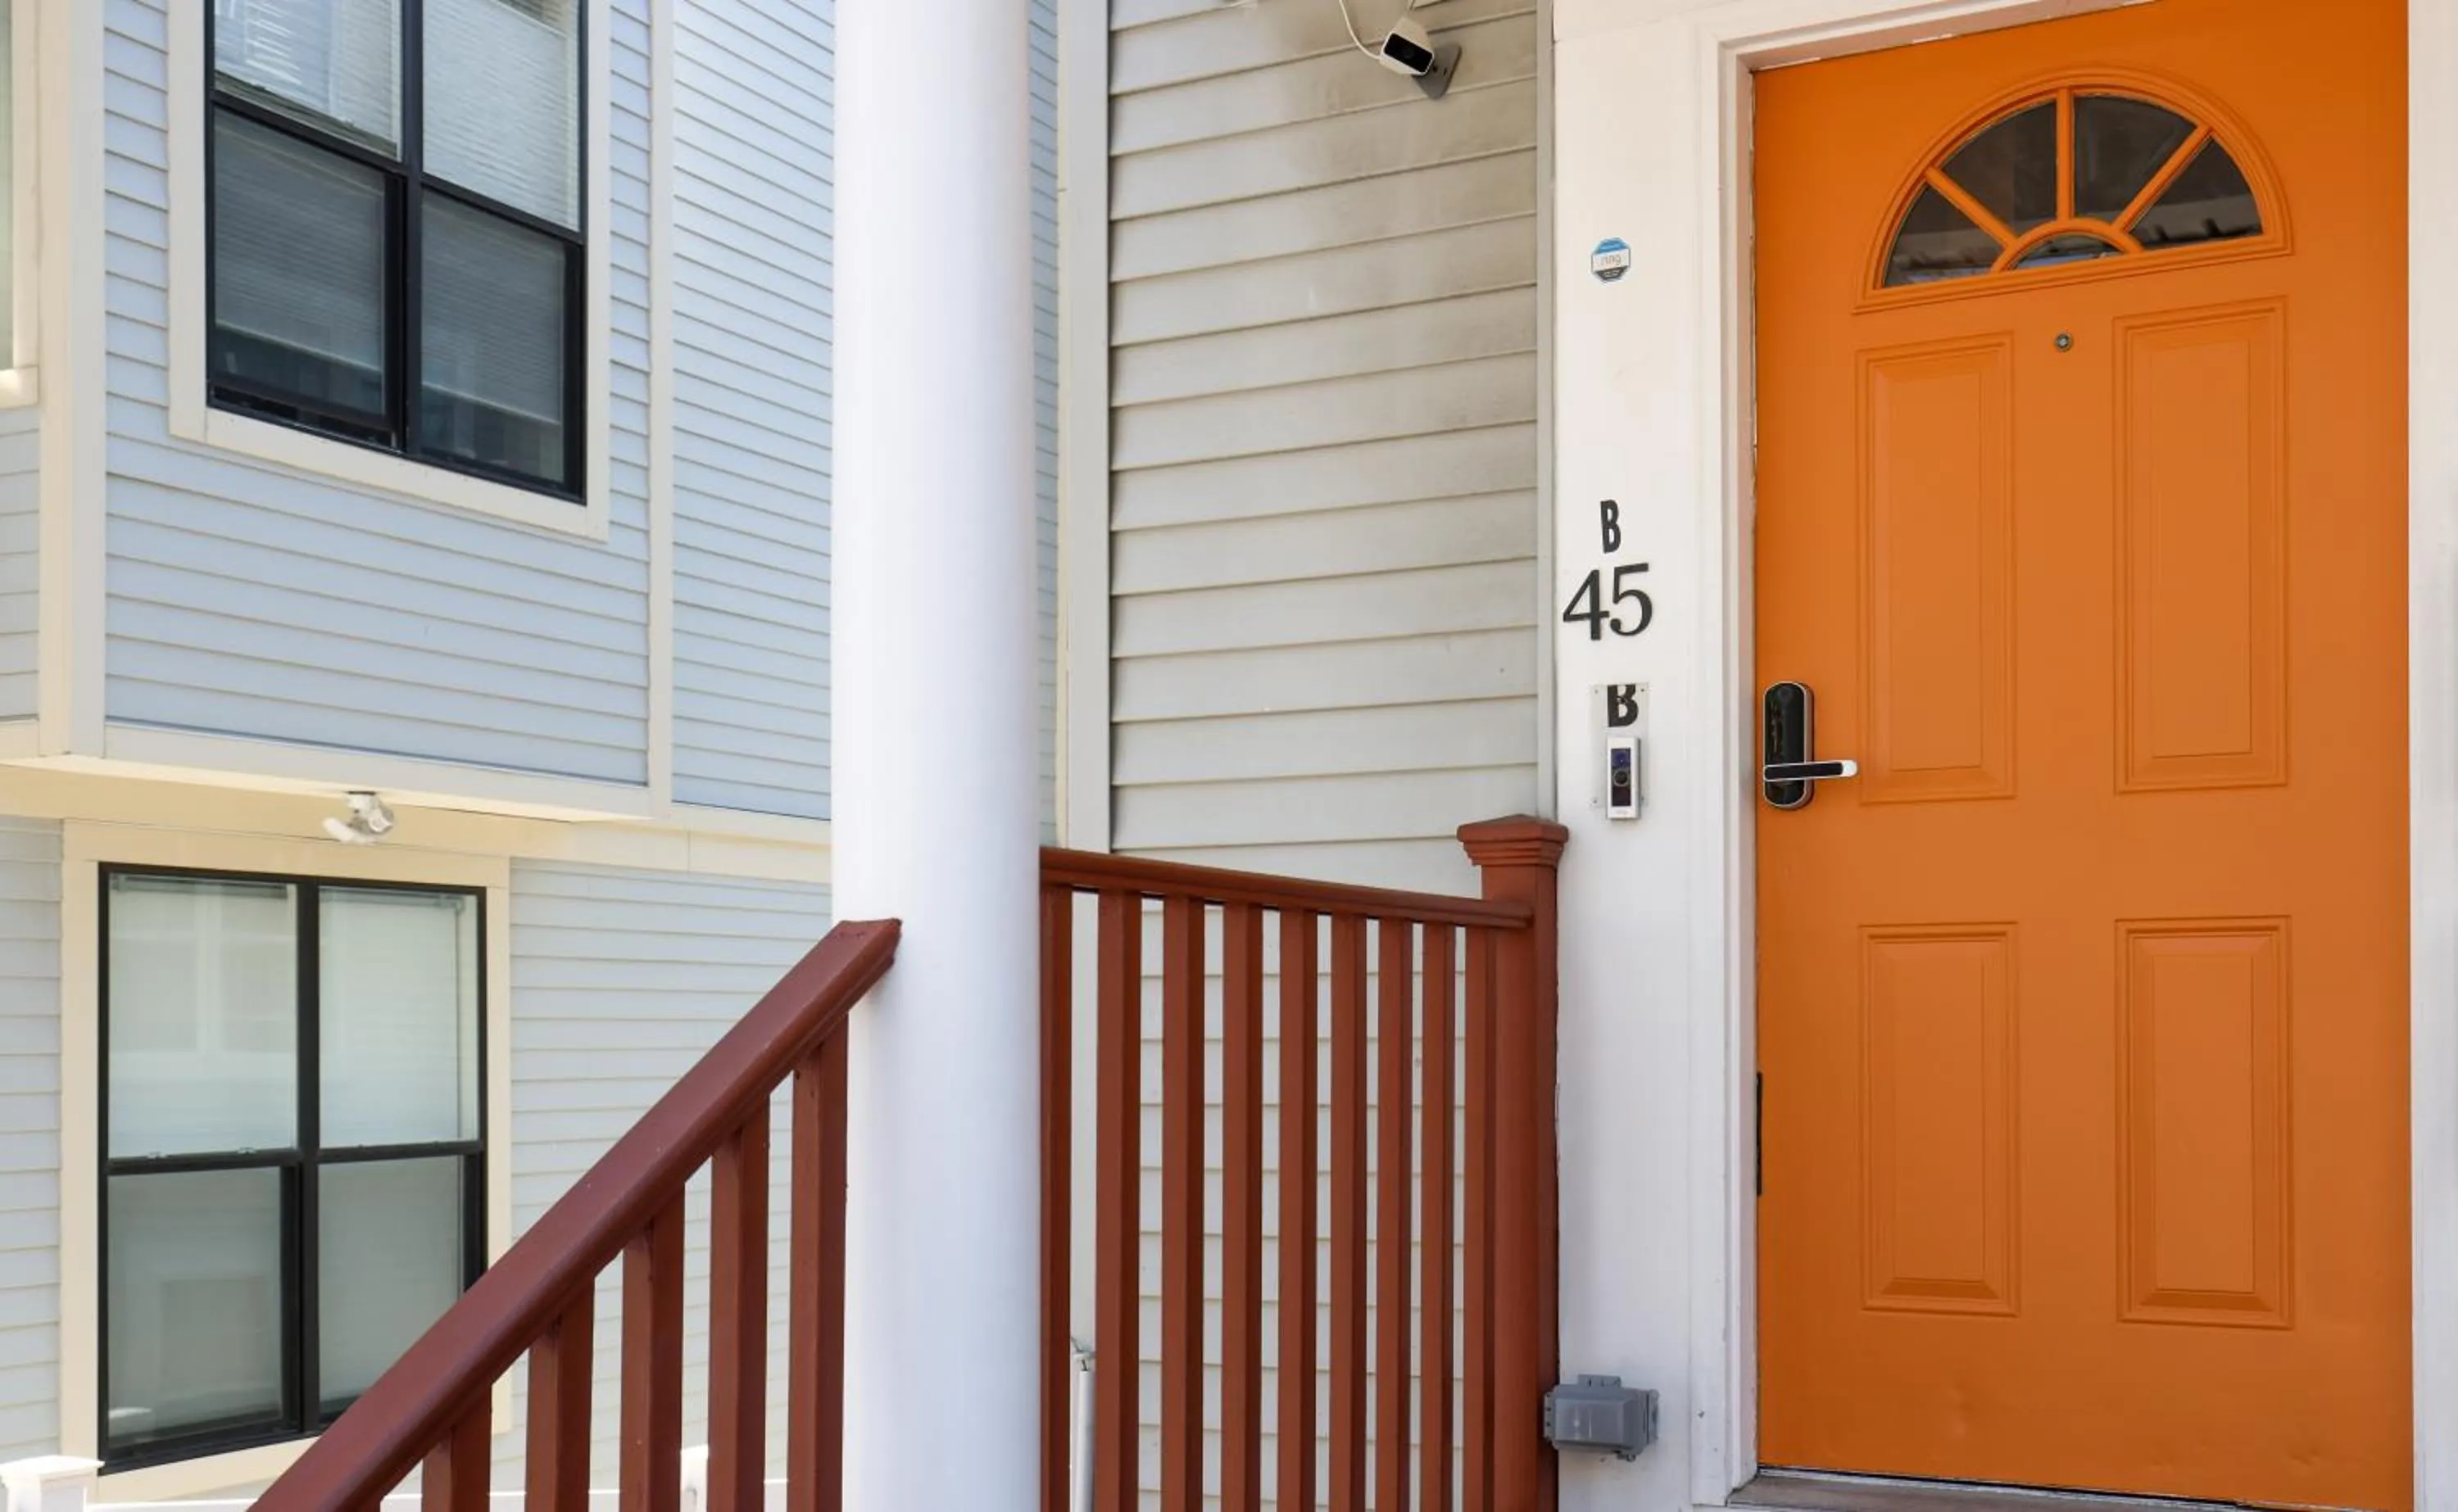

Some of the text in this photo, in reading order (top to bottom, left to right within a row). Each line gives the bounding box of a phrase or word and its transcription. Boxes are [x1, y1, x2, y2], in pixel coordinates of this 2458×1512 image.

[1600, 499, 1621, 554] B
[1562, 563, 1653, 641] 45
[1607, 684, 1639, 728] B
